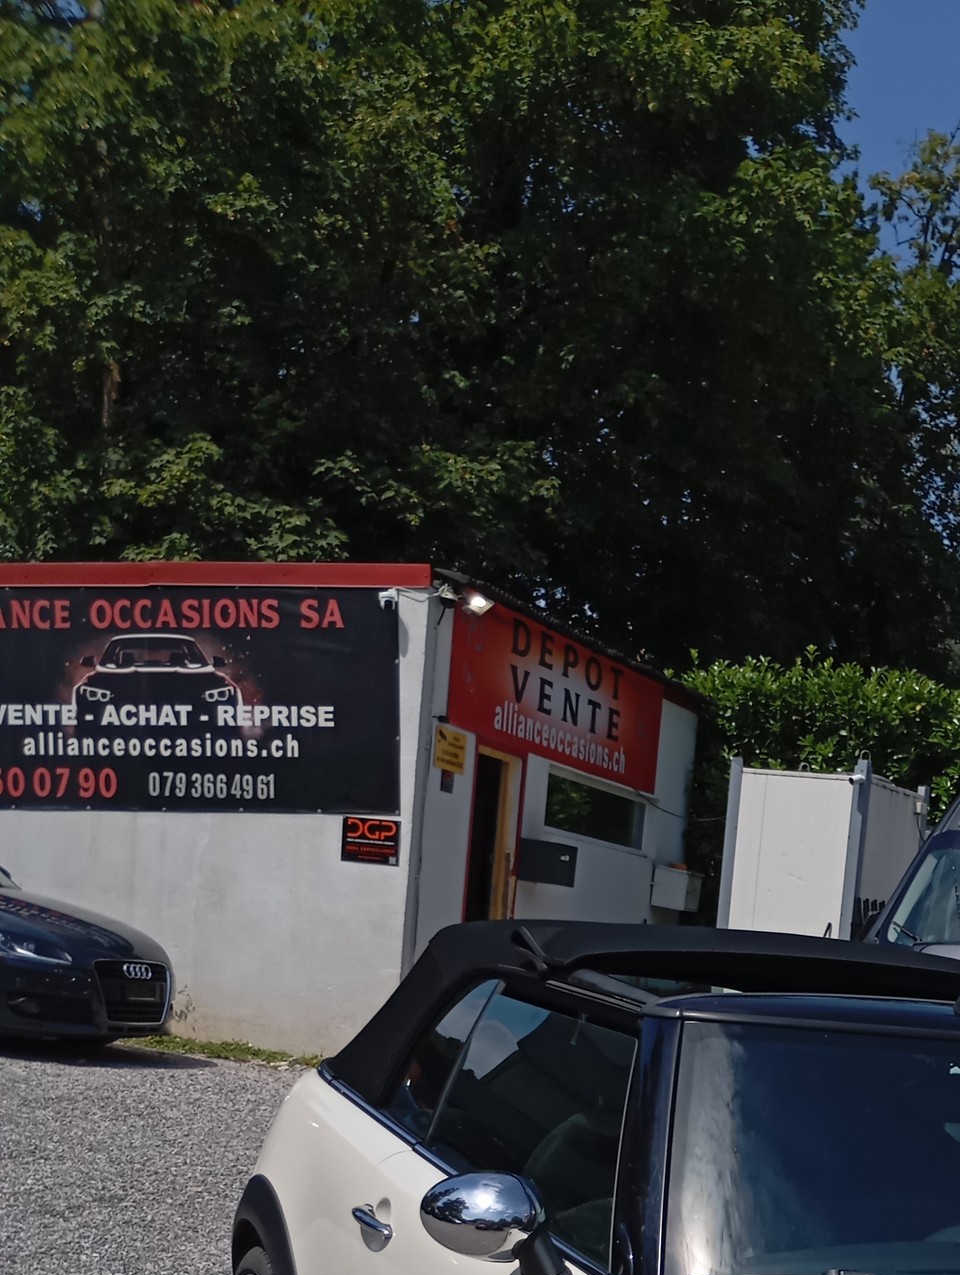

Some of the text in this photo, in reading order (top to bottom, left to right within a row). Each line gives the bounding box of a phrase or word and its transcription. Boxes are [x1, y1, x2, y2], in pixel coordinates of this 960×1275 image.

[90, 598, 281, 630] OCCASIONS
[301, 598, 345, 630] SA
[511, 617, 624, 700] DEPOT
[101, 704, 193, 727] ACHAT
[217, 705, 335, 728] REPRISE
[510, 664, 622, 742] VENTE
[23, 731, 300, 759] allianceoccasions.ch
[494, 700, 626, 774] allianceoccasions.ch
[0, 766, 26, 798] 0
[148, 771, 187, 797] 079
[191, 772, 227, 799] 366
[346, 818, 397, 840] DGP
